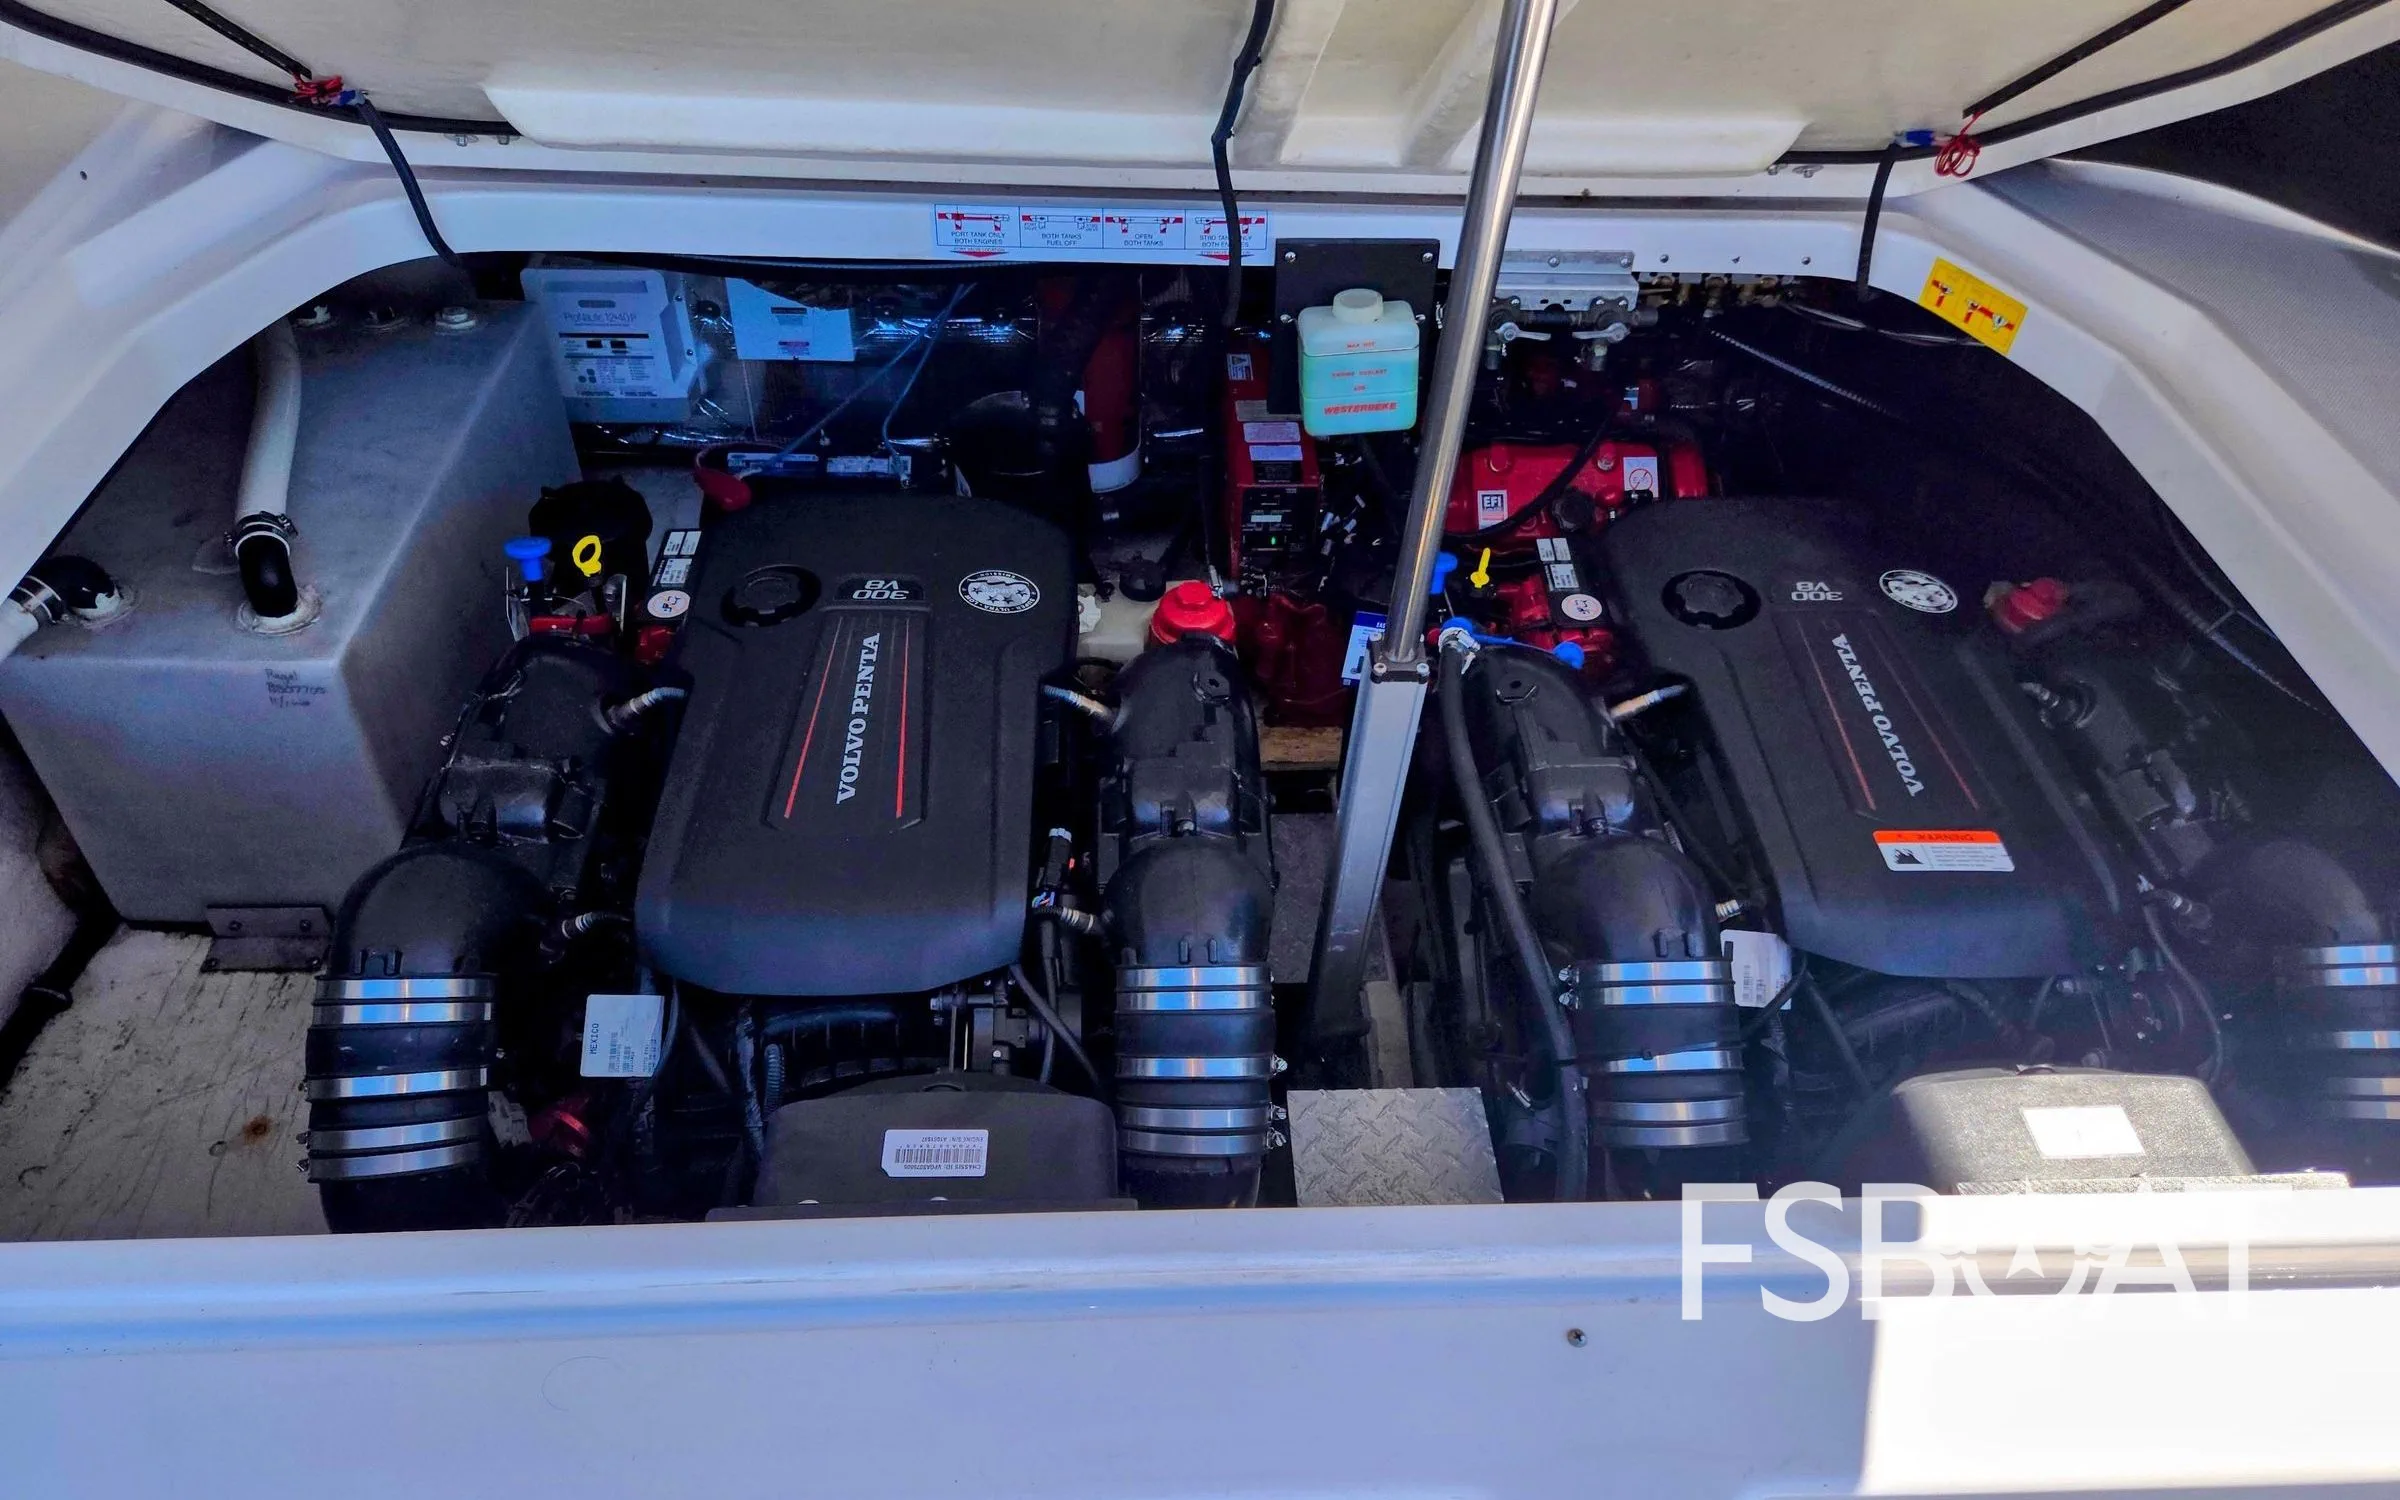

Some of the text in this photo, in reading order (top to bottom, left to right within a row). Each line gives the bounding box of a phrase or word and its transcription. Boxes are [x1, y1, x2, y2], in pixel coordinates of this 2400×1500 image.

[1324, 402, 1397, 415] WESTERBEKE
[1483, 496, 1502, 507] EFI
[864, 579, 899, 590] V8
[1795, 581, 1831, 592] V8
[852, 589, 910, 600] 300
[1791, 591, 1844, 601] 300
[836, 633, 880, 805] VOLVO PENTA
[1831, 633, 1925, 797] VOLVO PENTA
[1916, 833, 1975, 842] WARNING
[589, 1022, 600, 1056] MEXICO
